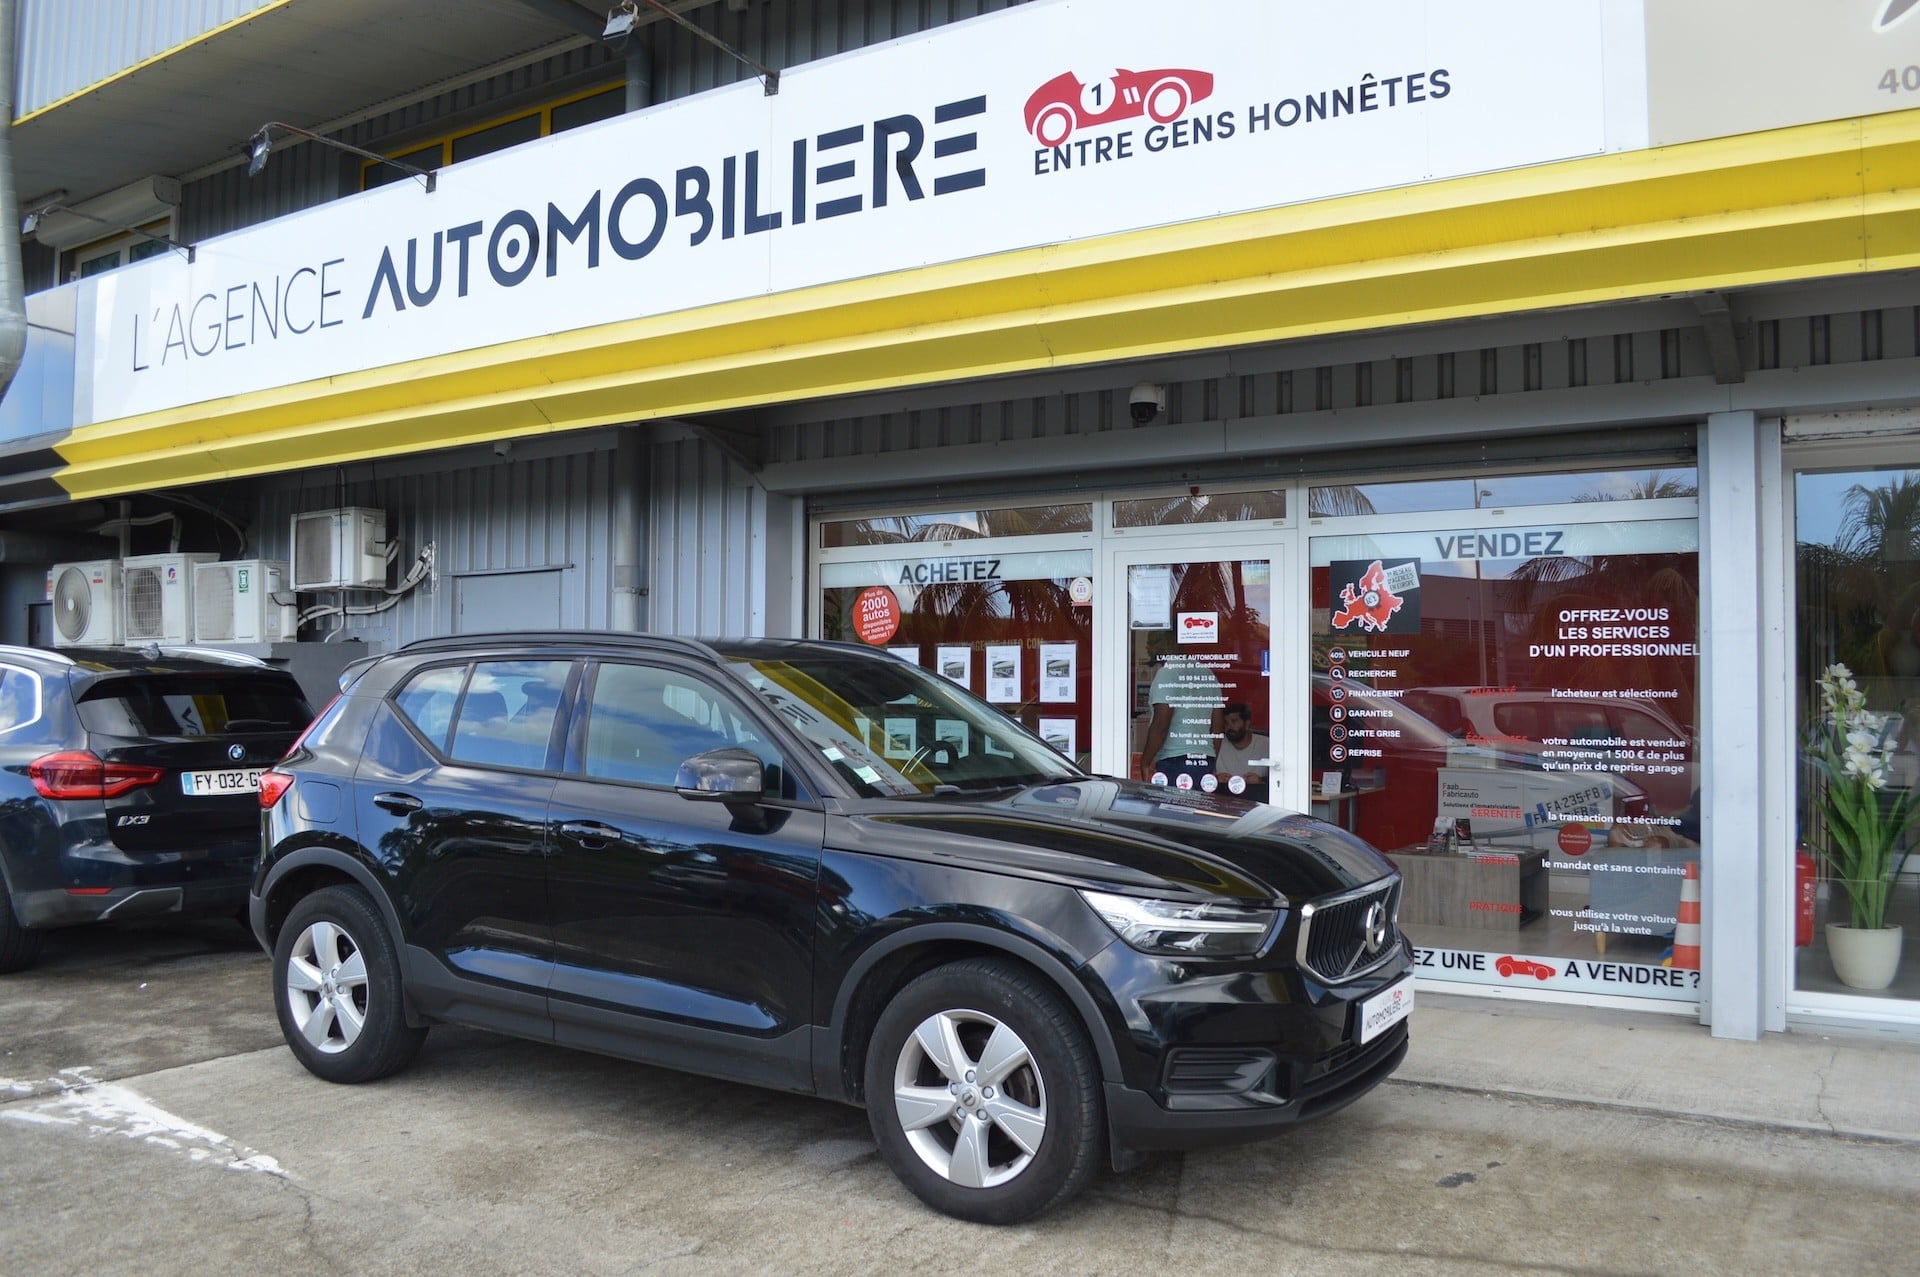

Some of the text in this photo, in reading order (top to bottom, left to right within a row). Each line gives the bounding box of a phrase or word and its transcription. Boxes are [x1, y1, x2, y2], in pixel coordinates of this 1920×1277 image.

[1091, 83, 1101, 106] 1
[1034, 69, 1451, 175] ENTRE GENS HONNÊTES
[133, 95, 986, 372] L'AGENCE AUTOMOBILIERE
[1435, 531, 1564, 560] VENDEZ
[899, 560, 1001, 584] ACHETEZ
[861, 595, 888, 612] 2000
[862, 608, 890, 622] autos
[1559, 608, 1669, 622] OFFREZ-VOUS
[1559, 626, 1670, 640] LES SERVICES
[1348, 650, 1387, 658] VEHICULE
[1529, 643, 1701, 657] D'UN PROFESSIONNEL
[1164, 662, 1187, 670] Agence
[1195, 662, 1231, 670] Guadeloupe
[1551, 687, 1678, 698] l'acheteur est sélectionné
[1376, 730, 1401, 738] GRISE
[1570, 737, 1628, 747] automobile
[1629, 738, 1645, 747] est
[1647, 738, 1686, 747] vendue
[1348, 749, 1382, 757] REPRISE
[1557, 752, 1603, 760] moyenne
[1606, 750, 1611, 759] 1
[1614, 750, 1635, 759] 500
[1637, 751, 1645, 760] €
[1646, 751, 1660, 760] de
[1662, 751, 1685, 762] plus
[1542, 762, 1685, 775] qu'un prix de reprise garage
[1442, 783, 1460, 791] Faab
[1442, 790, 1479, 799] Fabricauto
[1443, 801, 1469, 809] Solutions
[1547, 812, 1682, 826] la transaction est sécurisée
[1541, 859, 1687, 875] le mandat est sans contrainte
[1469, 902, 1523, 914] PRATIQUE
[1550, 908, 1677, 924] vous utilisez votre voiture
[1611, 922, 1621, 933] la
[1622, 925, 1652, 935] vente
[1442, 952, 1485, 971] UNE
[1565, 961, 1580, 978] A
[1587, 963, 1684, 988] VENDRE
